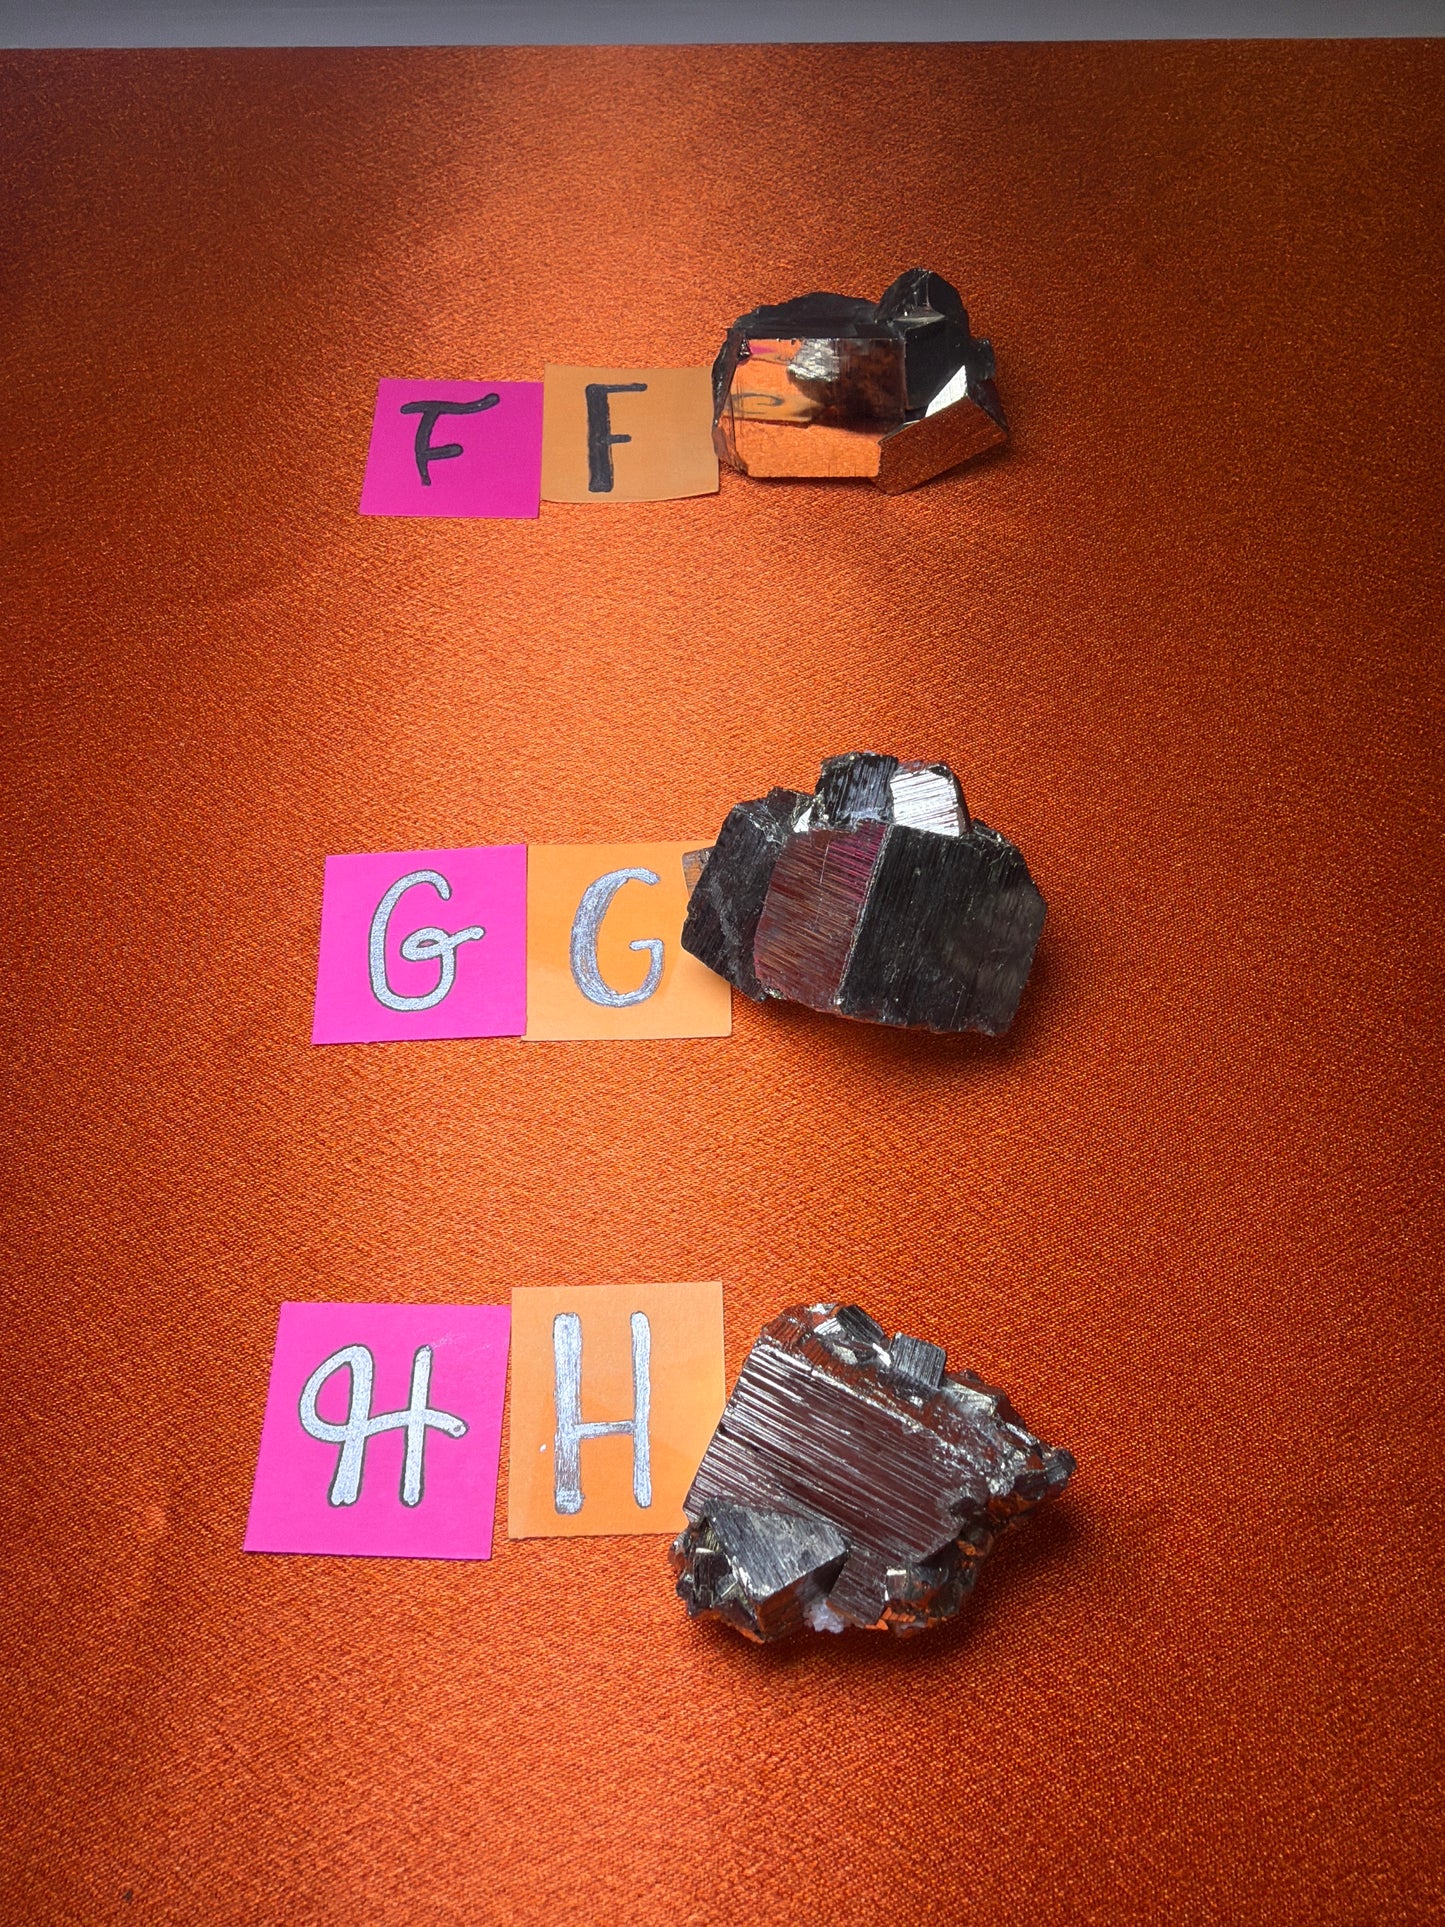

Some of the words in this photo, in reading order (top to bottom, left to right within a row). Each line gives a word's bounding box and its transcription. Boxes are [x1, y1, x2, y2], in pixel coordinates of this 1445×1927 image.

[400, 392, 501, 486] F
[585, 382, 648, 493] F
[367, 868, 487, 1013] G
[569, 866, 665, 1009] G
[298, 1343, 470, 1508] H
[552, 1310, 652, 1515] H
